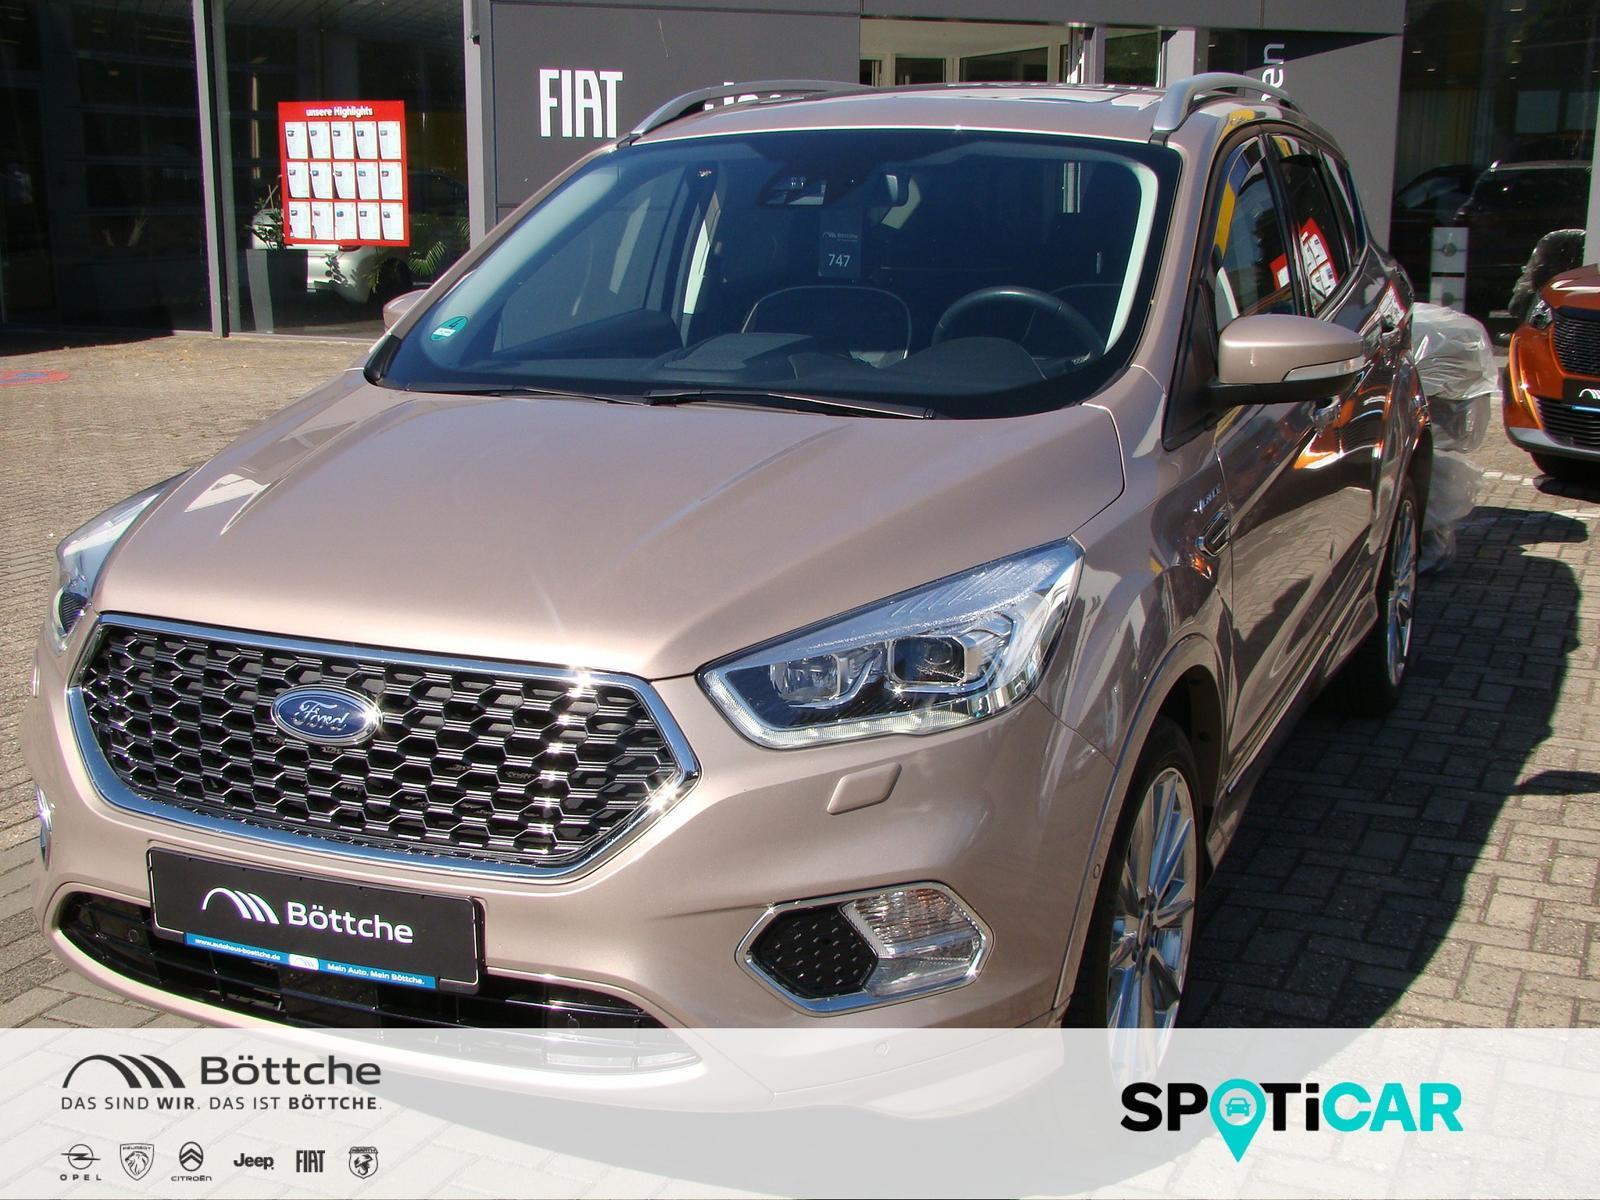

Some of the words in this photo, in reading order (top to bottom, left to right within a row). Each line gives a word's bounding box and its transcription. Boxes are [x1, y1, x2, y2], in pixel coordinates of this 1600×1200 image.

[1261, 44, 1285, 102] en
[305, 108, 333, 117] unsere
[333, 106, 374, 118] Highlights
[539, 69, 623, 139] FIAT
[828, 253, 850, 267] 747
[294, 700, 350, 731] Ford
[287, 901, 414, 944] Böttche
[327, 963, 347, 973] Mein
[347, 967, 370, 977] Auto.
[370, 970, 390, 980] Mein
[391, 973, 425, 985] Böttche.
